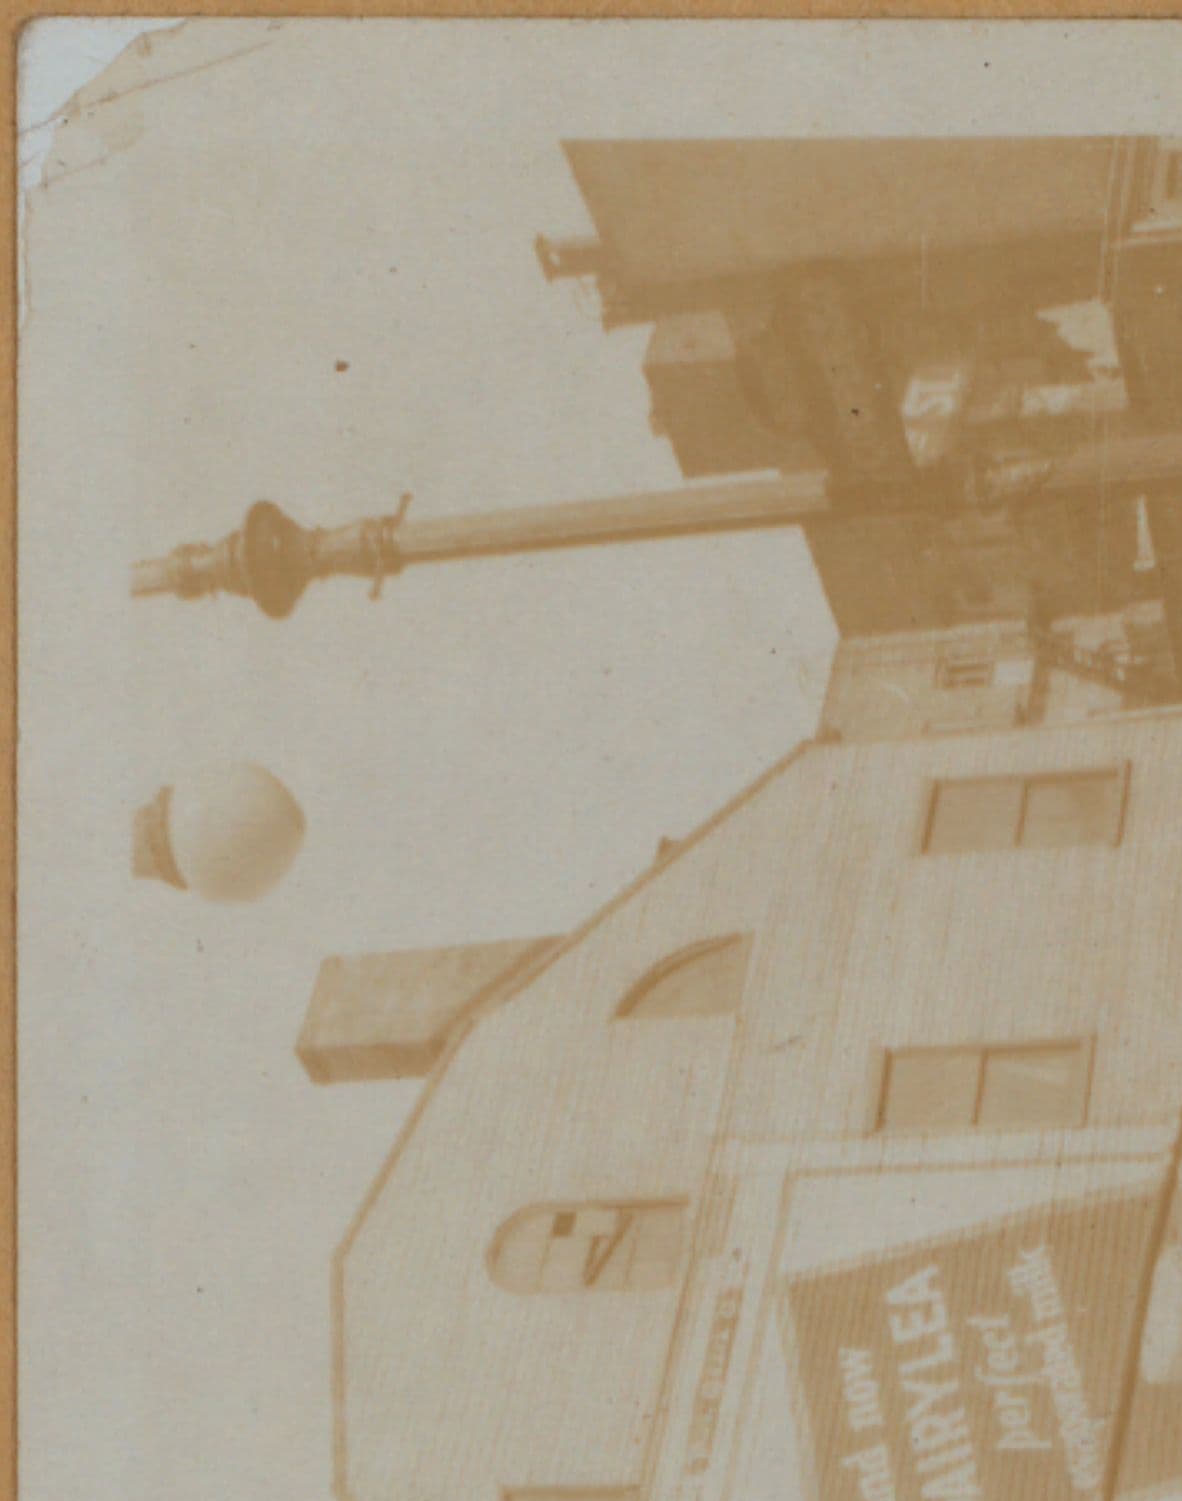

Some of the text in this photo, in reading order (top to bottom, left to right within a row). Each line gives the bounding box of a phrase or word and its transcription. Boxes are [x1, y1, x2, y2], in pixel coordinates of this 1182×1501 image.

[1005, 1243, 1068, 1321] milk
[838, 1344, 884, 1432] now
[966, 1311, 1053, 1451] perfect
